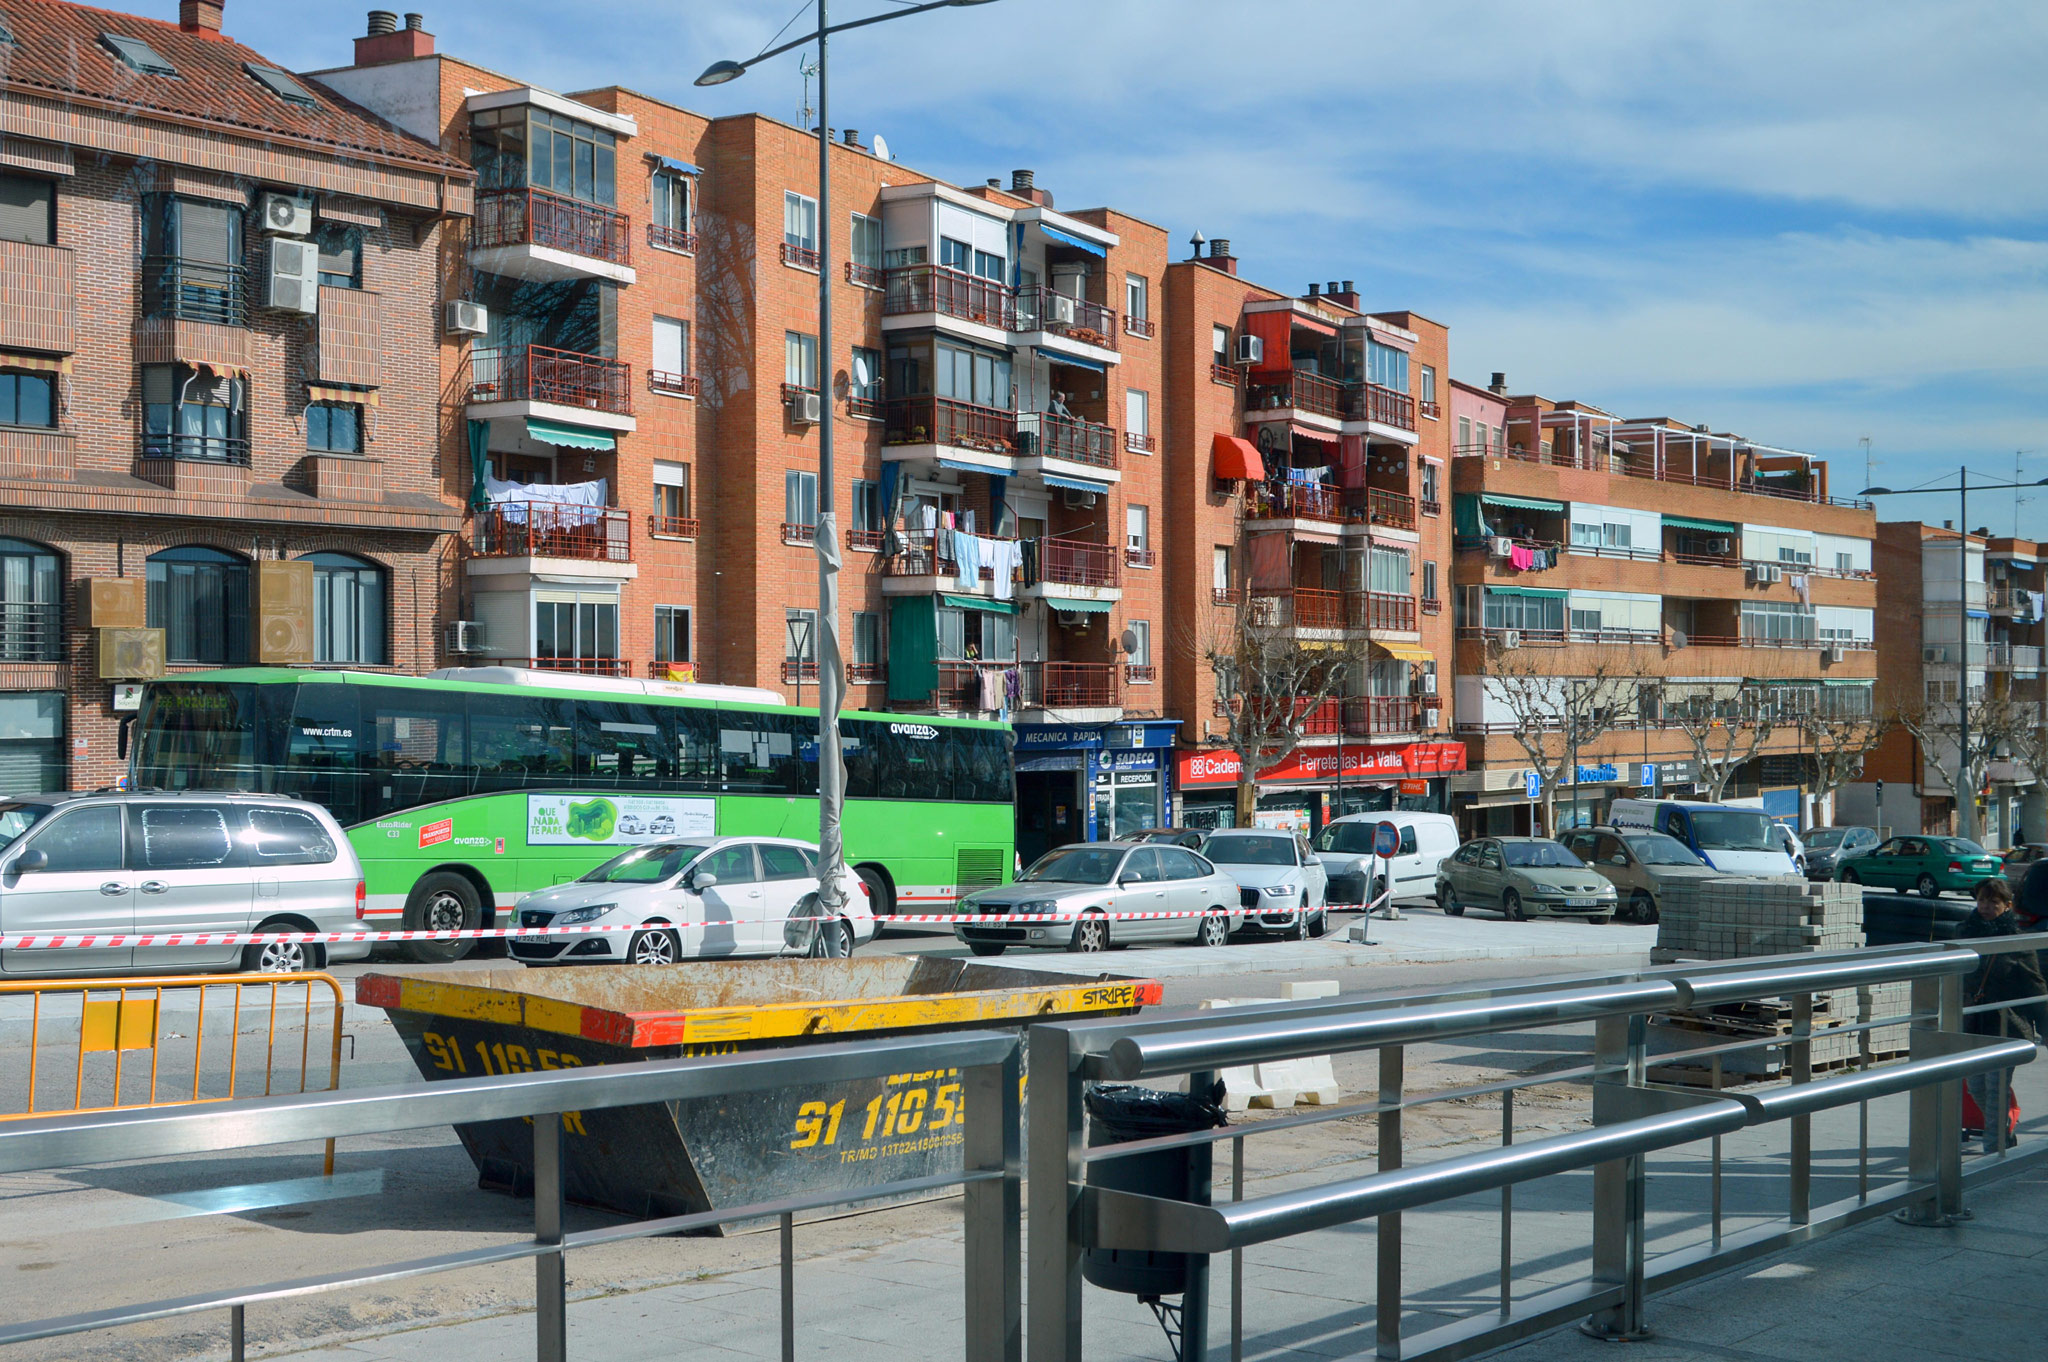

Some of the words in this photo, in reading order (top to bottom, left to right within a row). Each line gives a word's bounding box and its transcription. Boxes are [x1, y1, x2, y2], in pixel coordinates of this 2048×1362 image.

[302, 727, 353, 737] www.crtm.es
[890, 722, 929, 735] avanza
[1025, 731, 1068, 743] MECANICA
[1073, 731, 1101, 742] RAPIDA
[1115, 752, 1155, 765] SADECO
[1360, 752, 1375, 768] La
[1377, 750, 1403, 767] Valla
[1577, 762, 1619, 783] Boadilla
[1121, 773, 1152, 783] RECEPCIÓN
[1402, 783, 1423, 791] STIHL
[538, 807, 556, 817] QUE
[376, 821, 413, 829] EuroRider
[534, 817, 559, 826] NADA
[530, 826, 540, 835] TE
[541, 826, 563, 835] PARE
[454, 837, 485, 845] avanza
[423, 1031, 467, 1073] 91
[475, 1040, 534, 1076] 110
[790, 1098, 846, 1149] 91
[862, 1088, 928, 1140] 110
